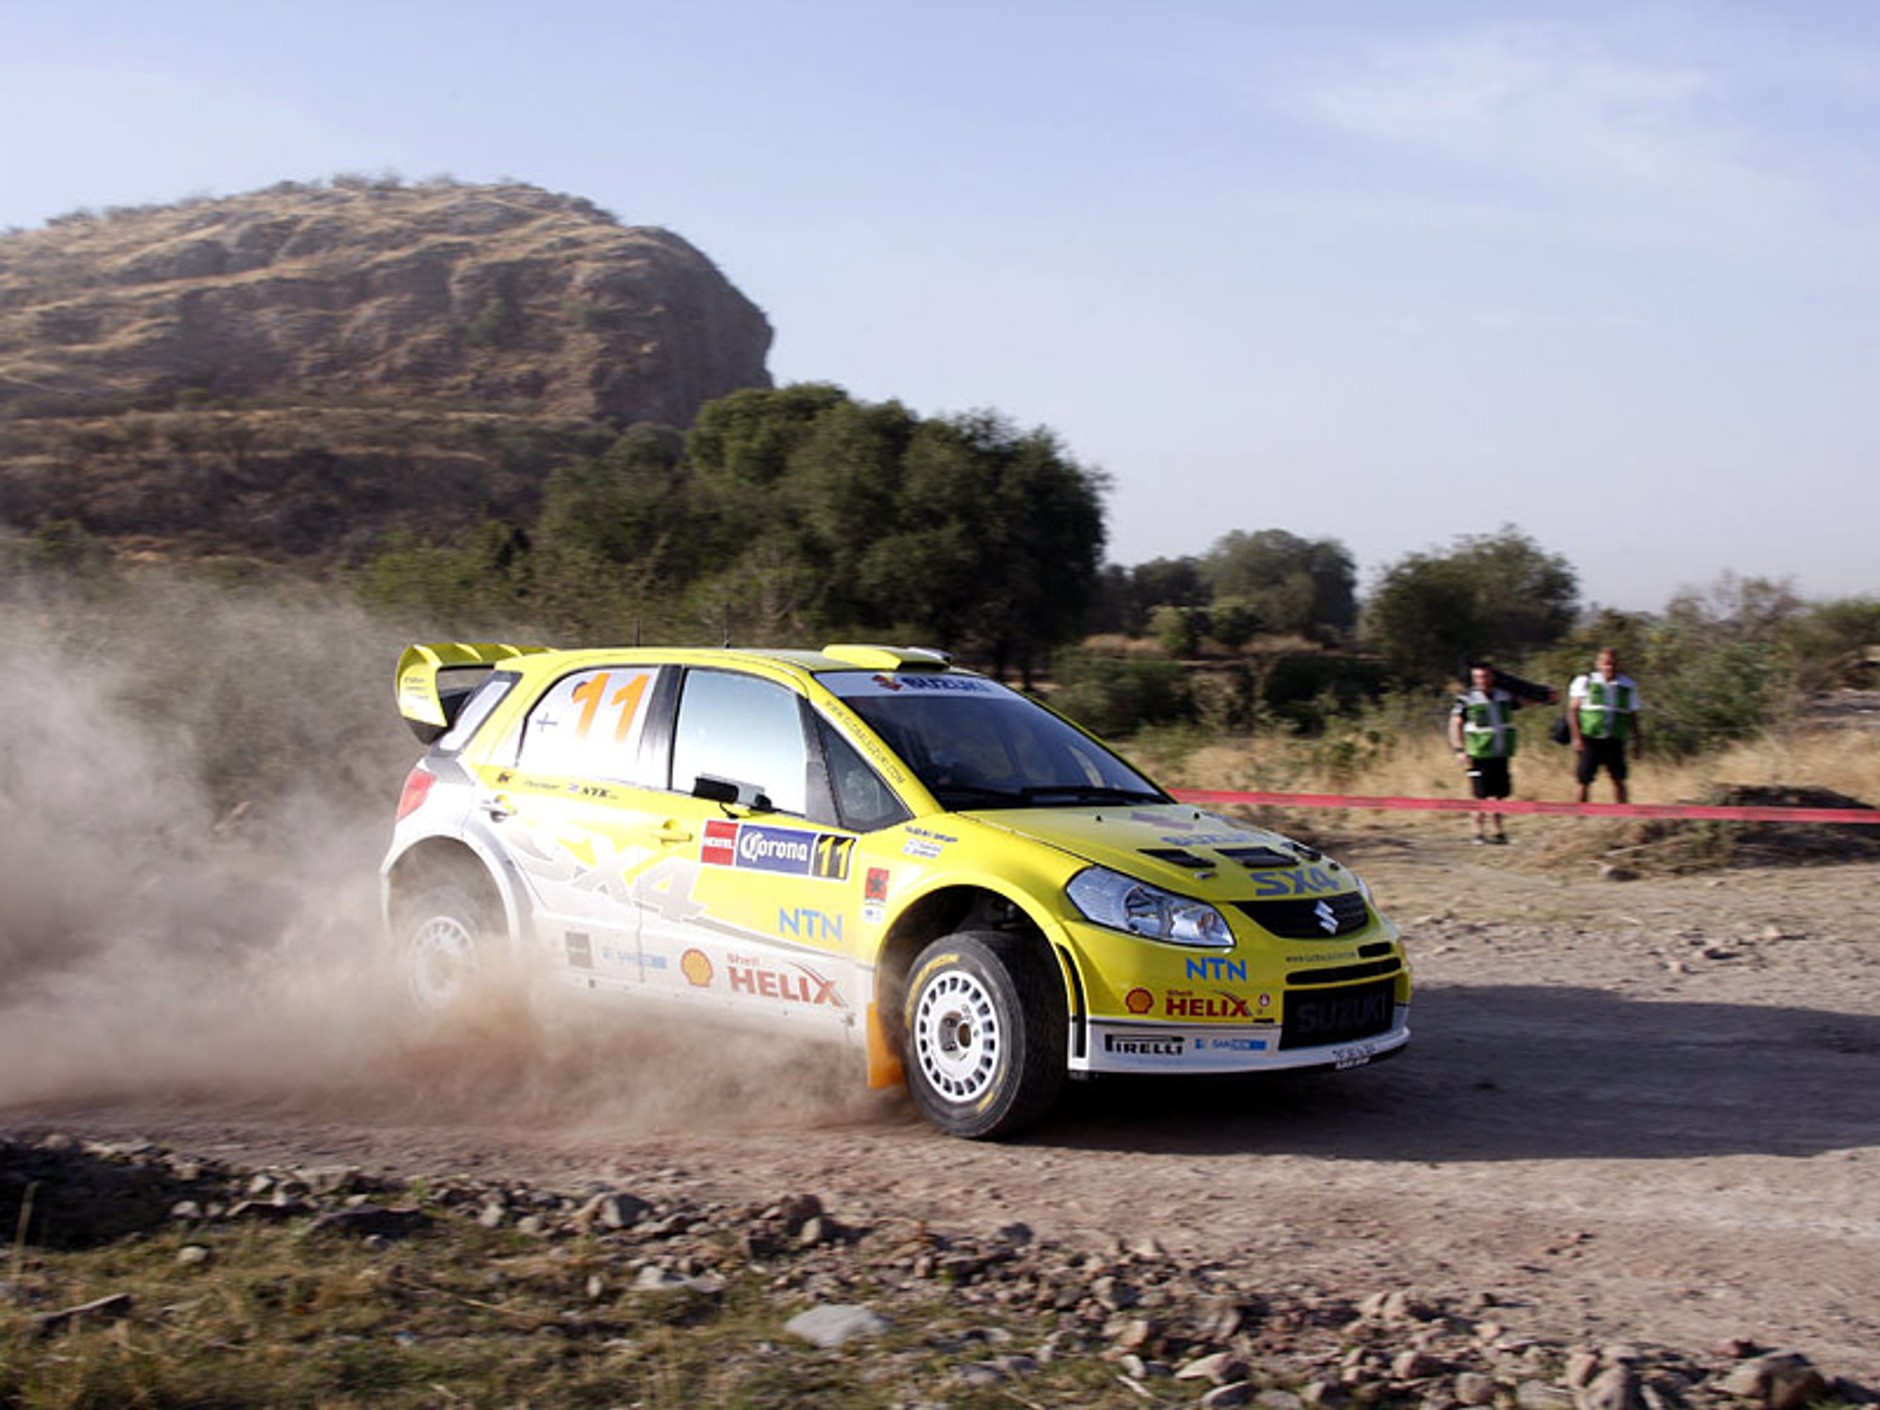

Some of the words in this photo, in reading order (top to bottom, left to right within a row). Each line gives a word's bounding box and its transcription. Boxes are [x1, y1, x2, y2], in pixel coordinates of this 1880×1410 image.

[571, 673, 651, 743] 11
[740, 832, 807, 862] Corona
[818, 836, 854, 878] 11
[1250, 867, 1340, 895] SX4
[779, 907, 843, 941] NTN
[1185, 957, 1247, 981] NTN
[728, 963, 843, 1008] HELIX
[1165, 996, 1251, 1017] HELIX
[1296, 992, 1386, 1033] SUZUKI
[1105, 1034, 1185, 1056] PIRELLI
